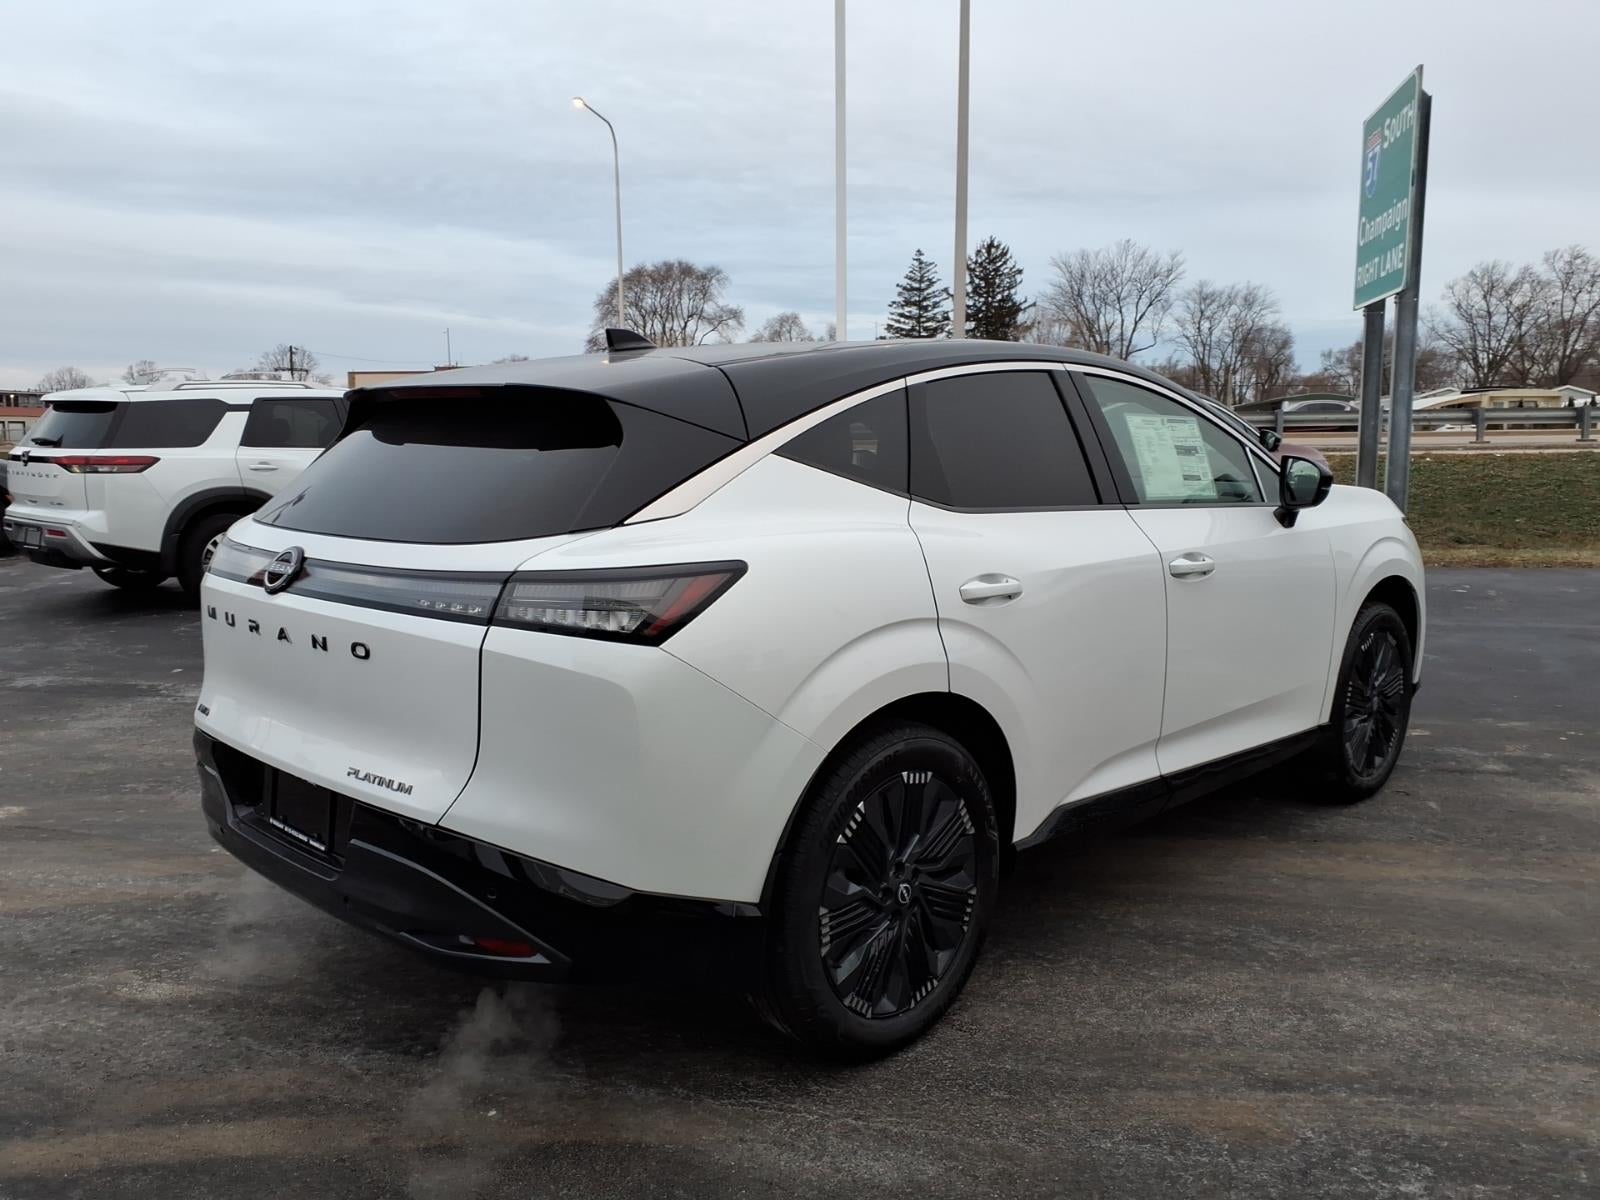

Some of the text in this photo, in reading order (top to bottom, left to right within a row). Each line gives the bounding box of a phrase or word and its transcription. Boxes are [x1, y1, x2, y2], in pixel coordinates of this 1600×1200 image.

[1383, 100, 1414, 149] SOUTH
[1366, 145, 1381, 187] 57
[1359, 199, 1407, 246] Champaign
[1356, 242, 1405, 289] RIGHT LANE
[207, 604, 371, 660] MURANO
[346, 766, 414, 796] PLATINUM
